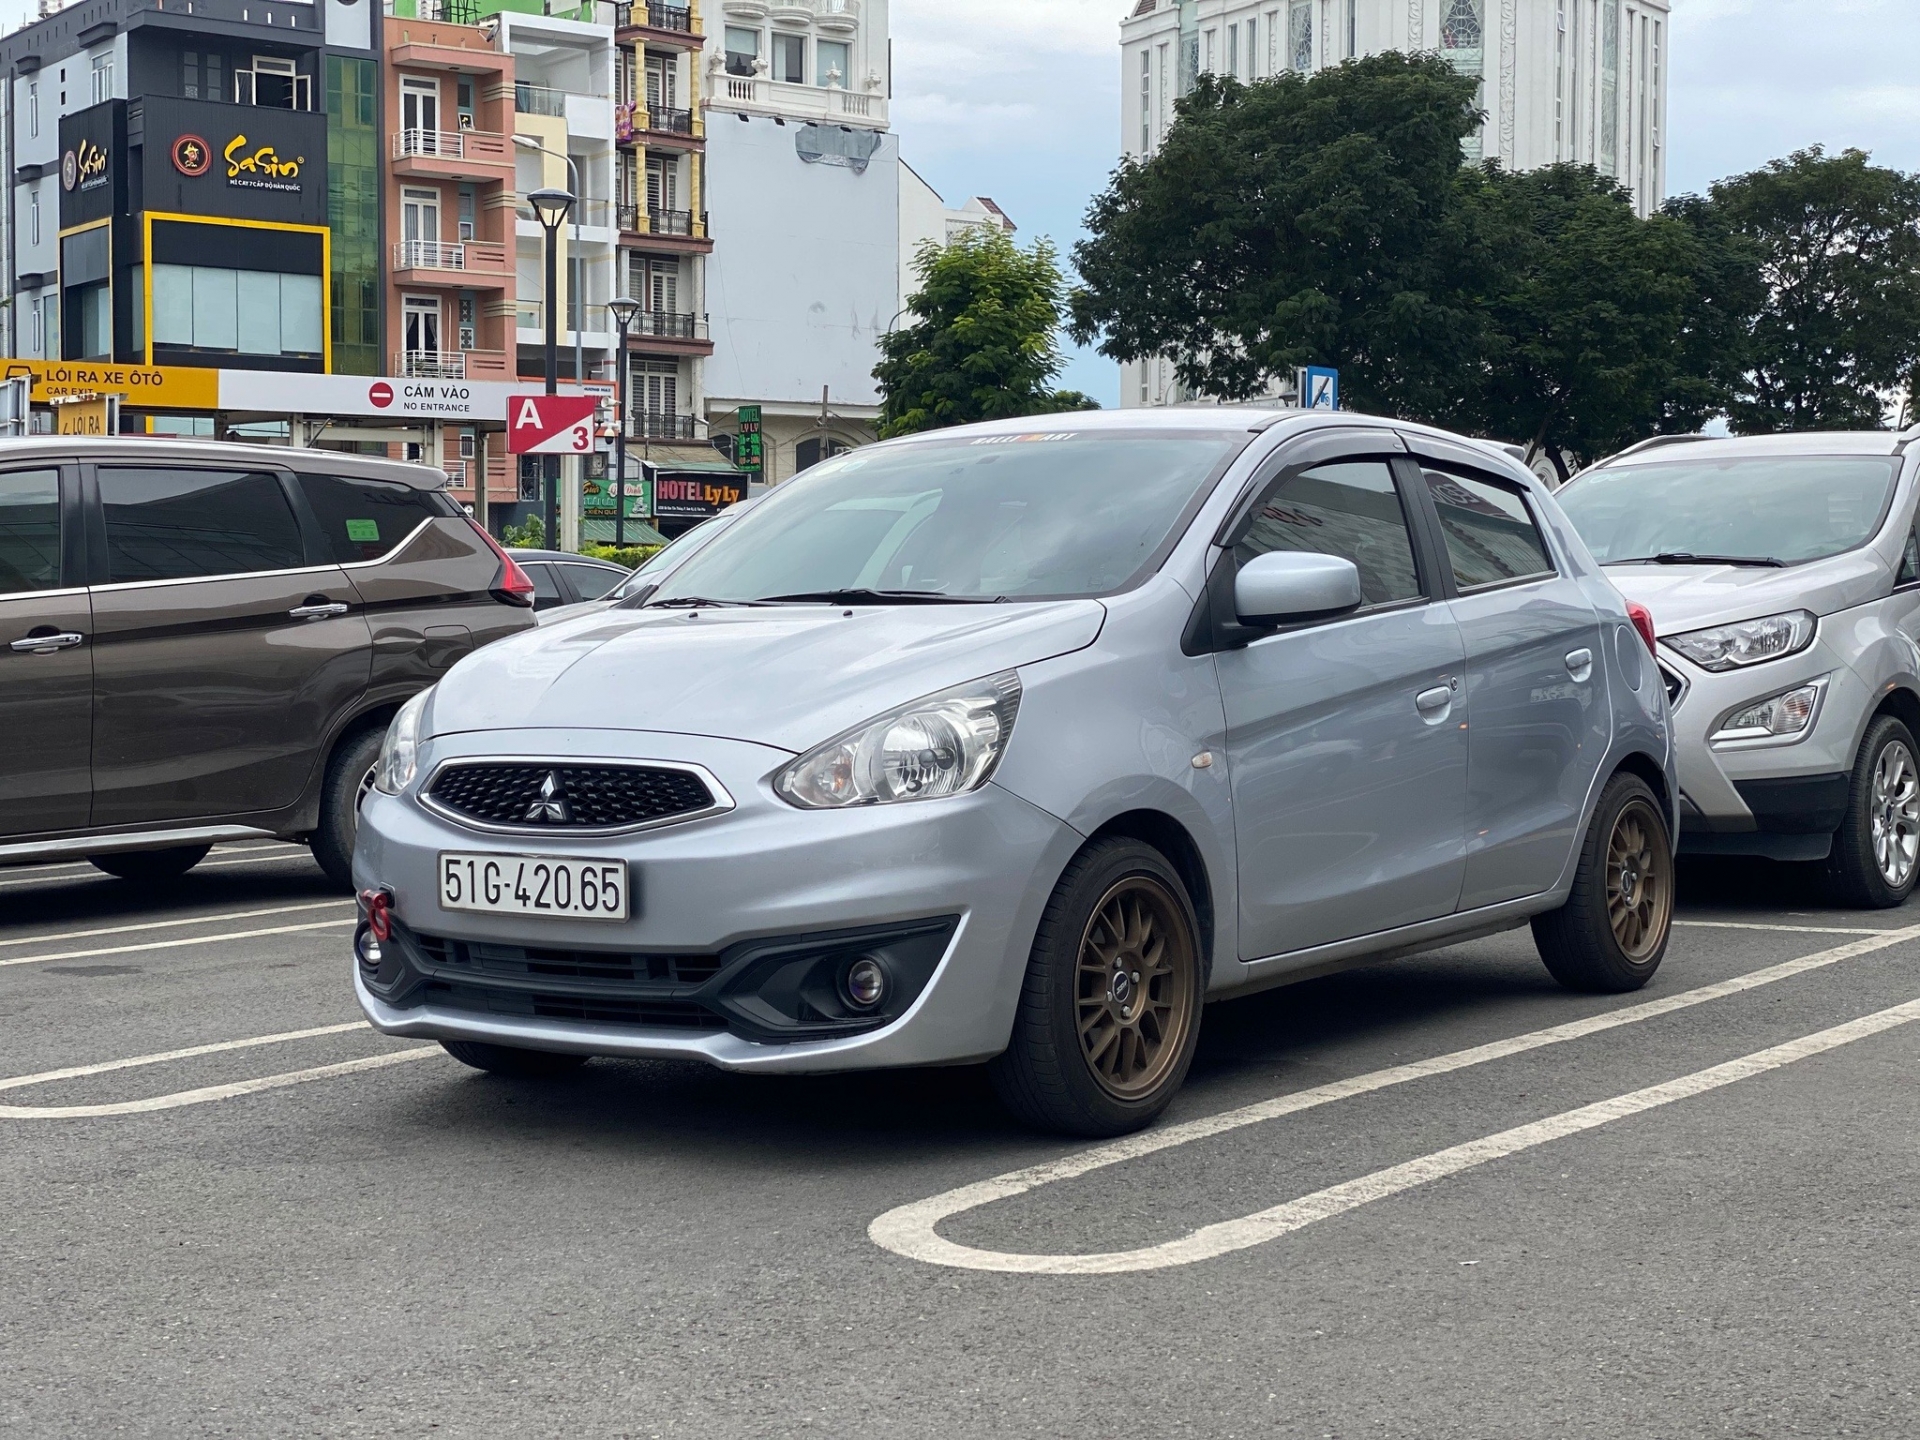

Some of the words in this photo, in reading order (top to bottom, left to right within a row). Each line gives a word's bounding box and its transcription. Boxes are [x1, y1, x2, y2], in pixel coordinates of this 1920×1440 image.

[77, 371, 99, 383] RA
[103, 372, 124, 384] XE
[130, 370, 163, 386] ÔTÔ
[46, 386, 68, 395] CAR
[71, 387, 93, 395] EXIT
[441, 384, 470, 400] VÀO
[403, 402, 417, 410] NO
[420, 402, 470, 412] ENTRANCE
[515, 398, 543, 429] A
[739, 408, 759, 422] HOTEL
[88, 415, 100, 434] RA
[572, 426, 589, 450] 3
[658, 480, 704, 501] HOTEL
[445, 858, 620, 912] 51G-420.65
